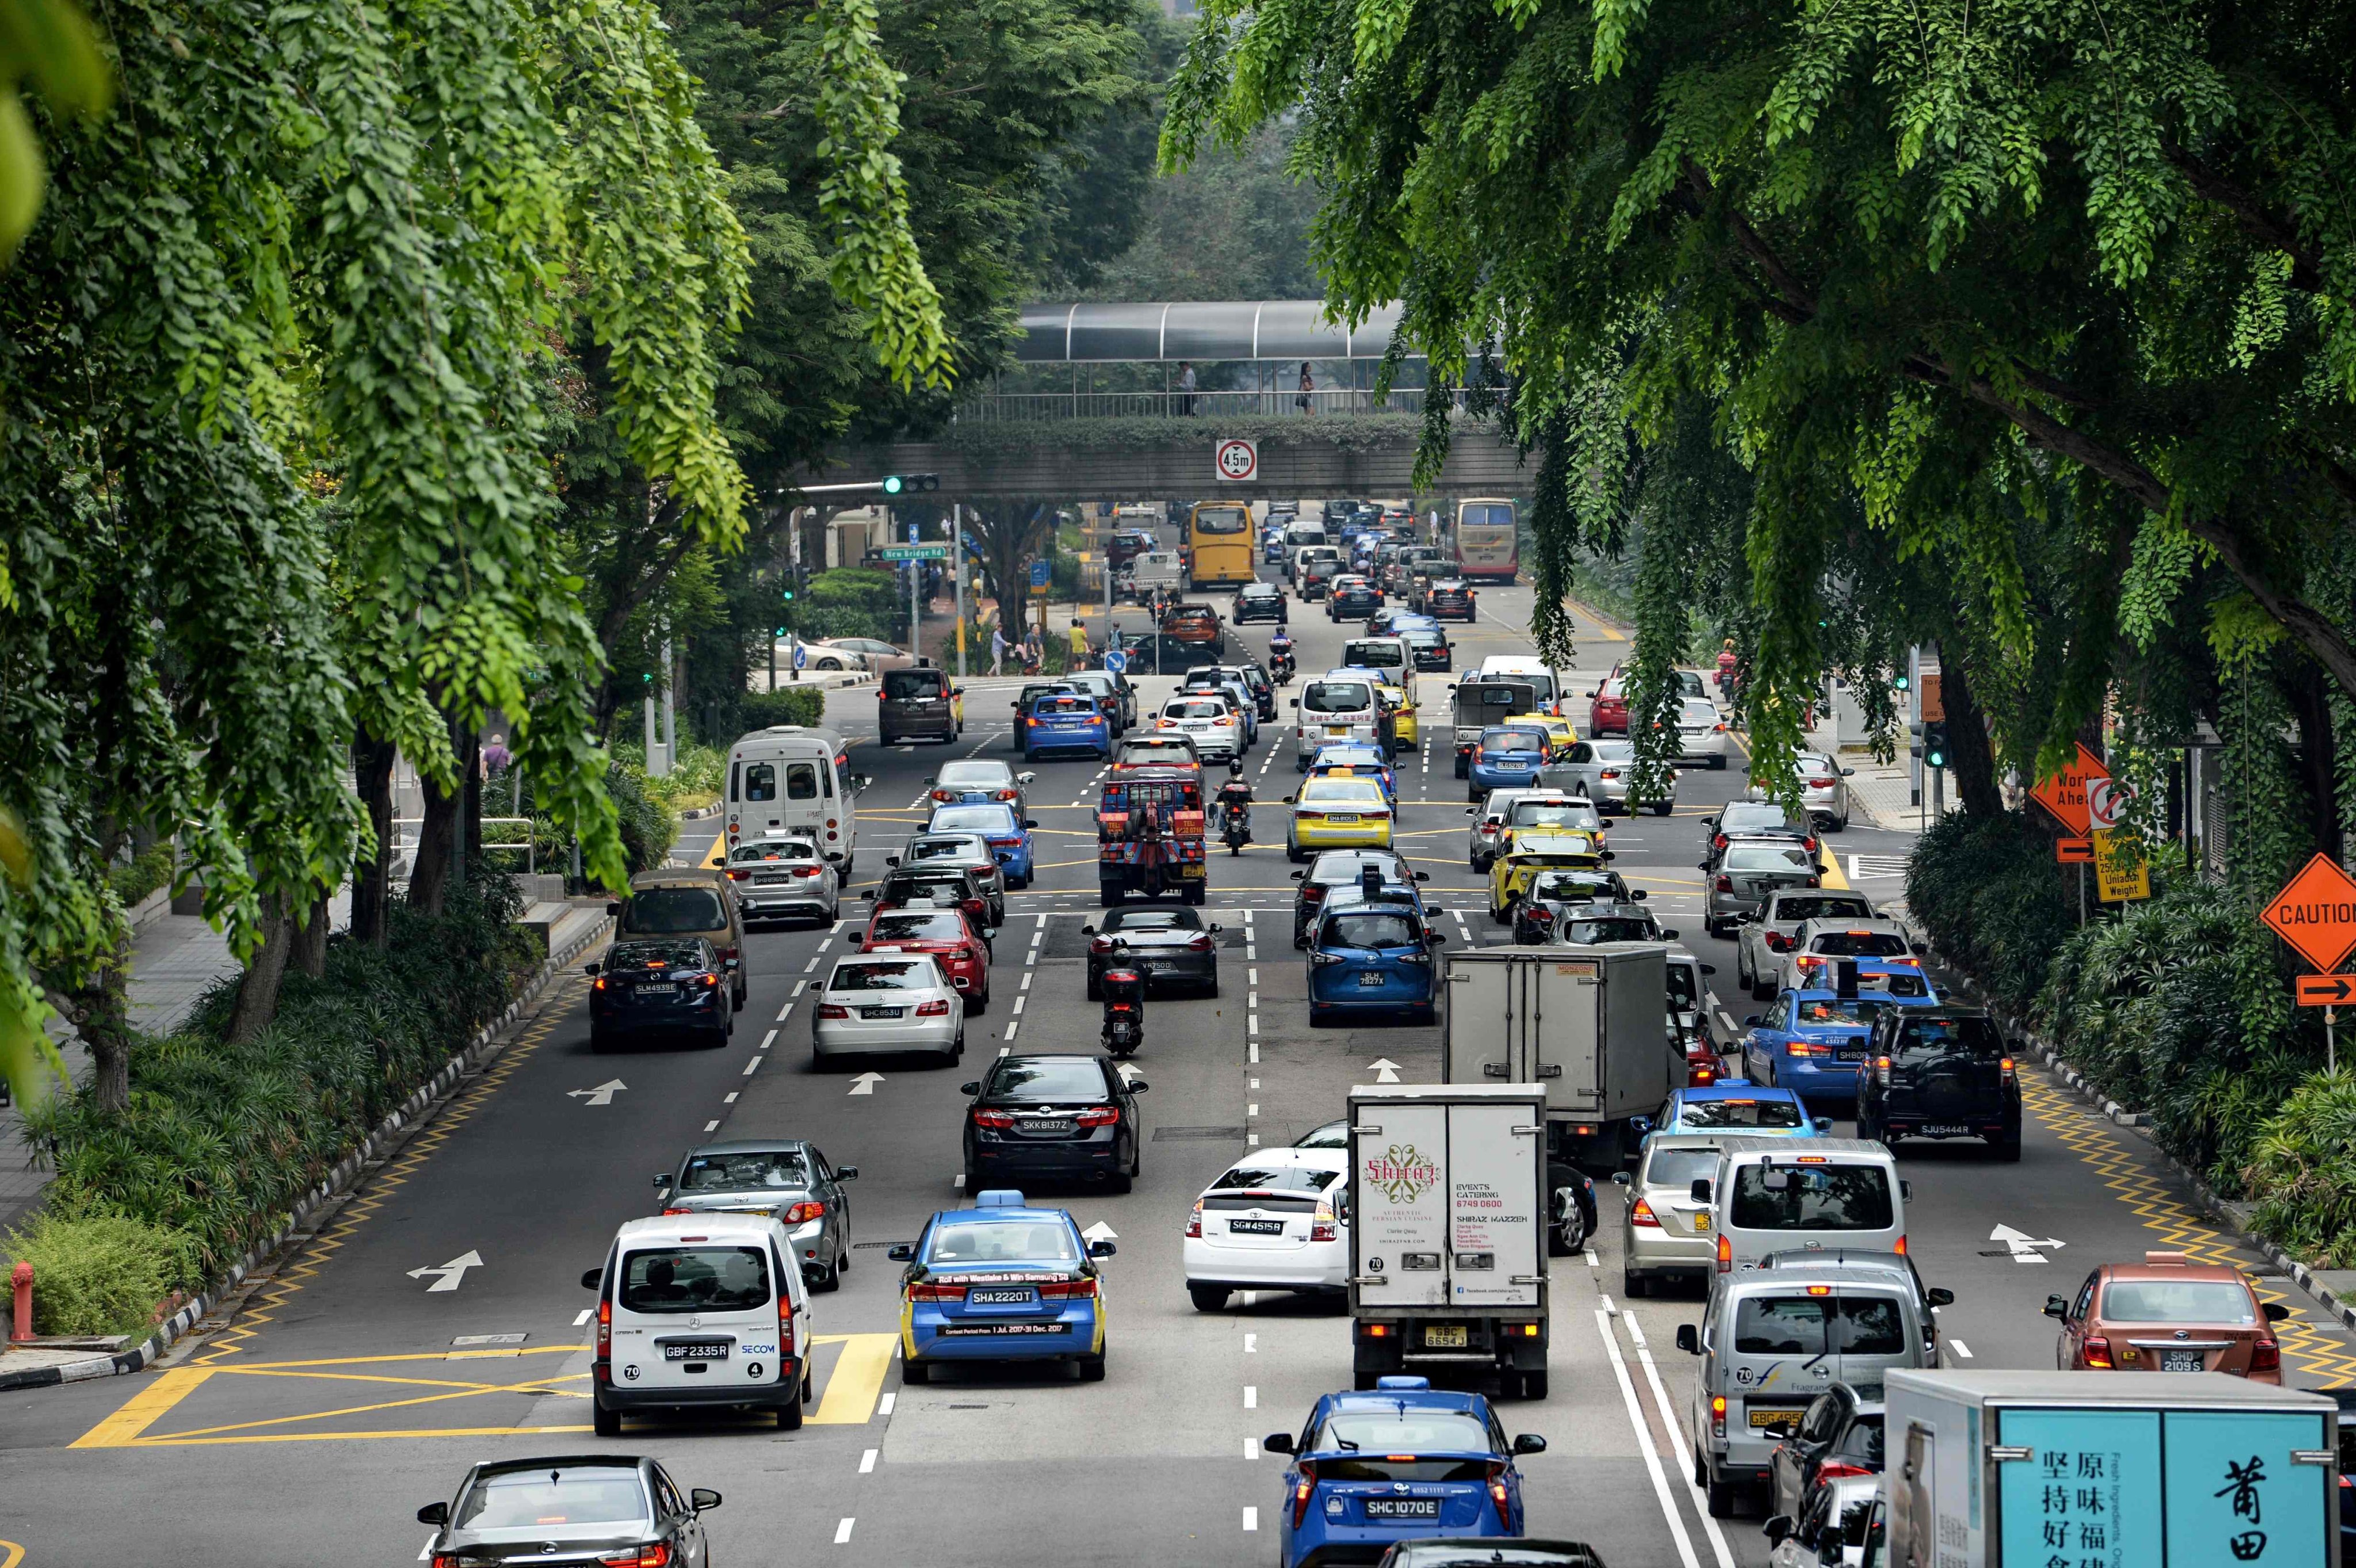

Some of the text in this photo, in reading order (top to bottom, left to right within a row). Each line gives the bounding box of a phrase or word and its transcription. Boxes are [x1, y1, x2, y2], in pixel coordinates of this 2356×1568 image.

[1223, 453, 1249, 466] 4.5m
[904, 549, 930, 559] Bridge
[932, 548, 942, 556] Rd
[2057, 772, 2101, 787] Work
[2057, 790, 2089, 805] Ahe
[2109, 885, 2139, 897] Weight
[637, 984, 676, 992] SLM4939E
[1023, 1120, 1068, 1130] SKK8137Z
[1922, 1126, 1968, 1134] SJU5444R
[1368, 1160, 1435, 1185] Shiraz
[1233, 1221, 1280, 1231] SGW4515B
[1371, 1259, 1381, 1267] 70
[939, 1275, 953, 1283] Roll
[970, 1274, 1002, 1282] Westlake
[1025, 1273, 1058, 1283] Samsung
[973, 1291, 1031, 1303] SHA2220T
[1008, 1325, 1032, 1333] 2017-31
[1436, 1328, 1458, 1336] GBC
[1427, 1337, 1464, 1345] 6654J
[666, 1346, 727, 1357] GBF2335R
[741, 1345, 775, 1353] SECOM
[2171, 1352, 2194, 1361] SHD
[625, 1367, 639, 1376] 70
[751, 1364, 758, 1373] 4
[2164, 1362, 2201, 1371] 2109S
[1739, 1370, 1752, 1379] 70
[1791, 1383, 1826, 1391] Fragran
[1751, 1413, 1802, 1424] GBG495
[2110, 1452, 2121, 1482] Fresh
[1368, 1502, 1435, 1513] SHC1070E
[2214, 1455, 2267, 1561] 莆田
